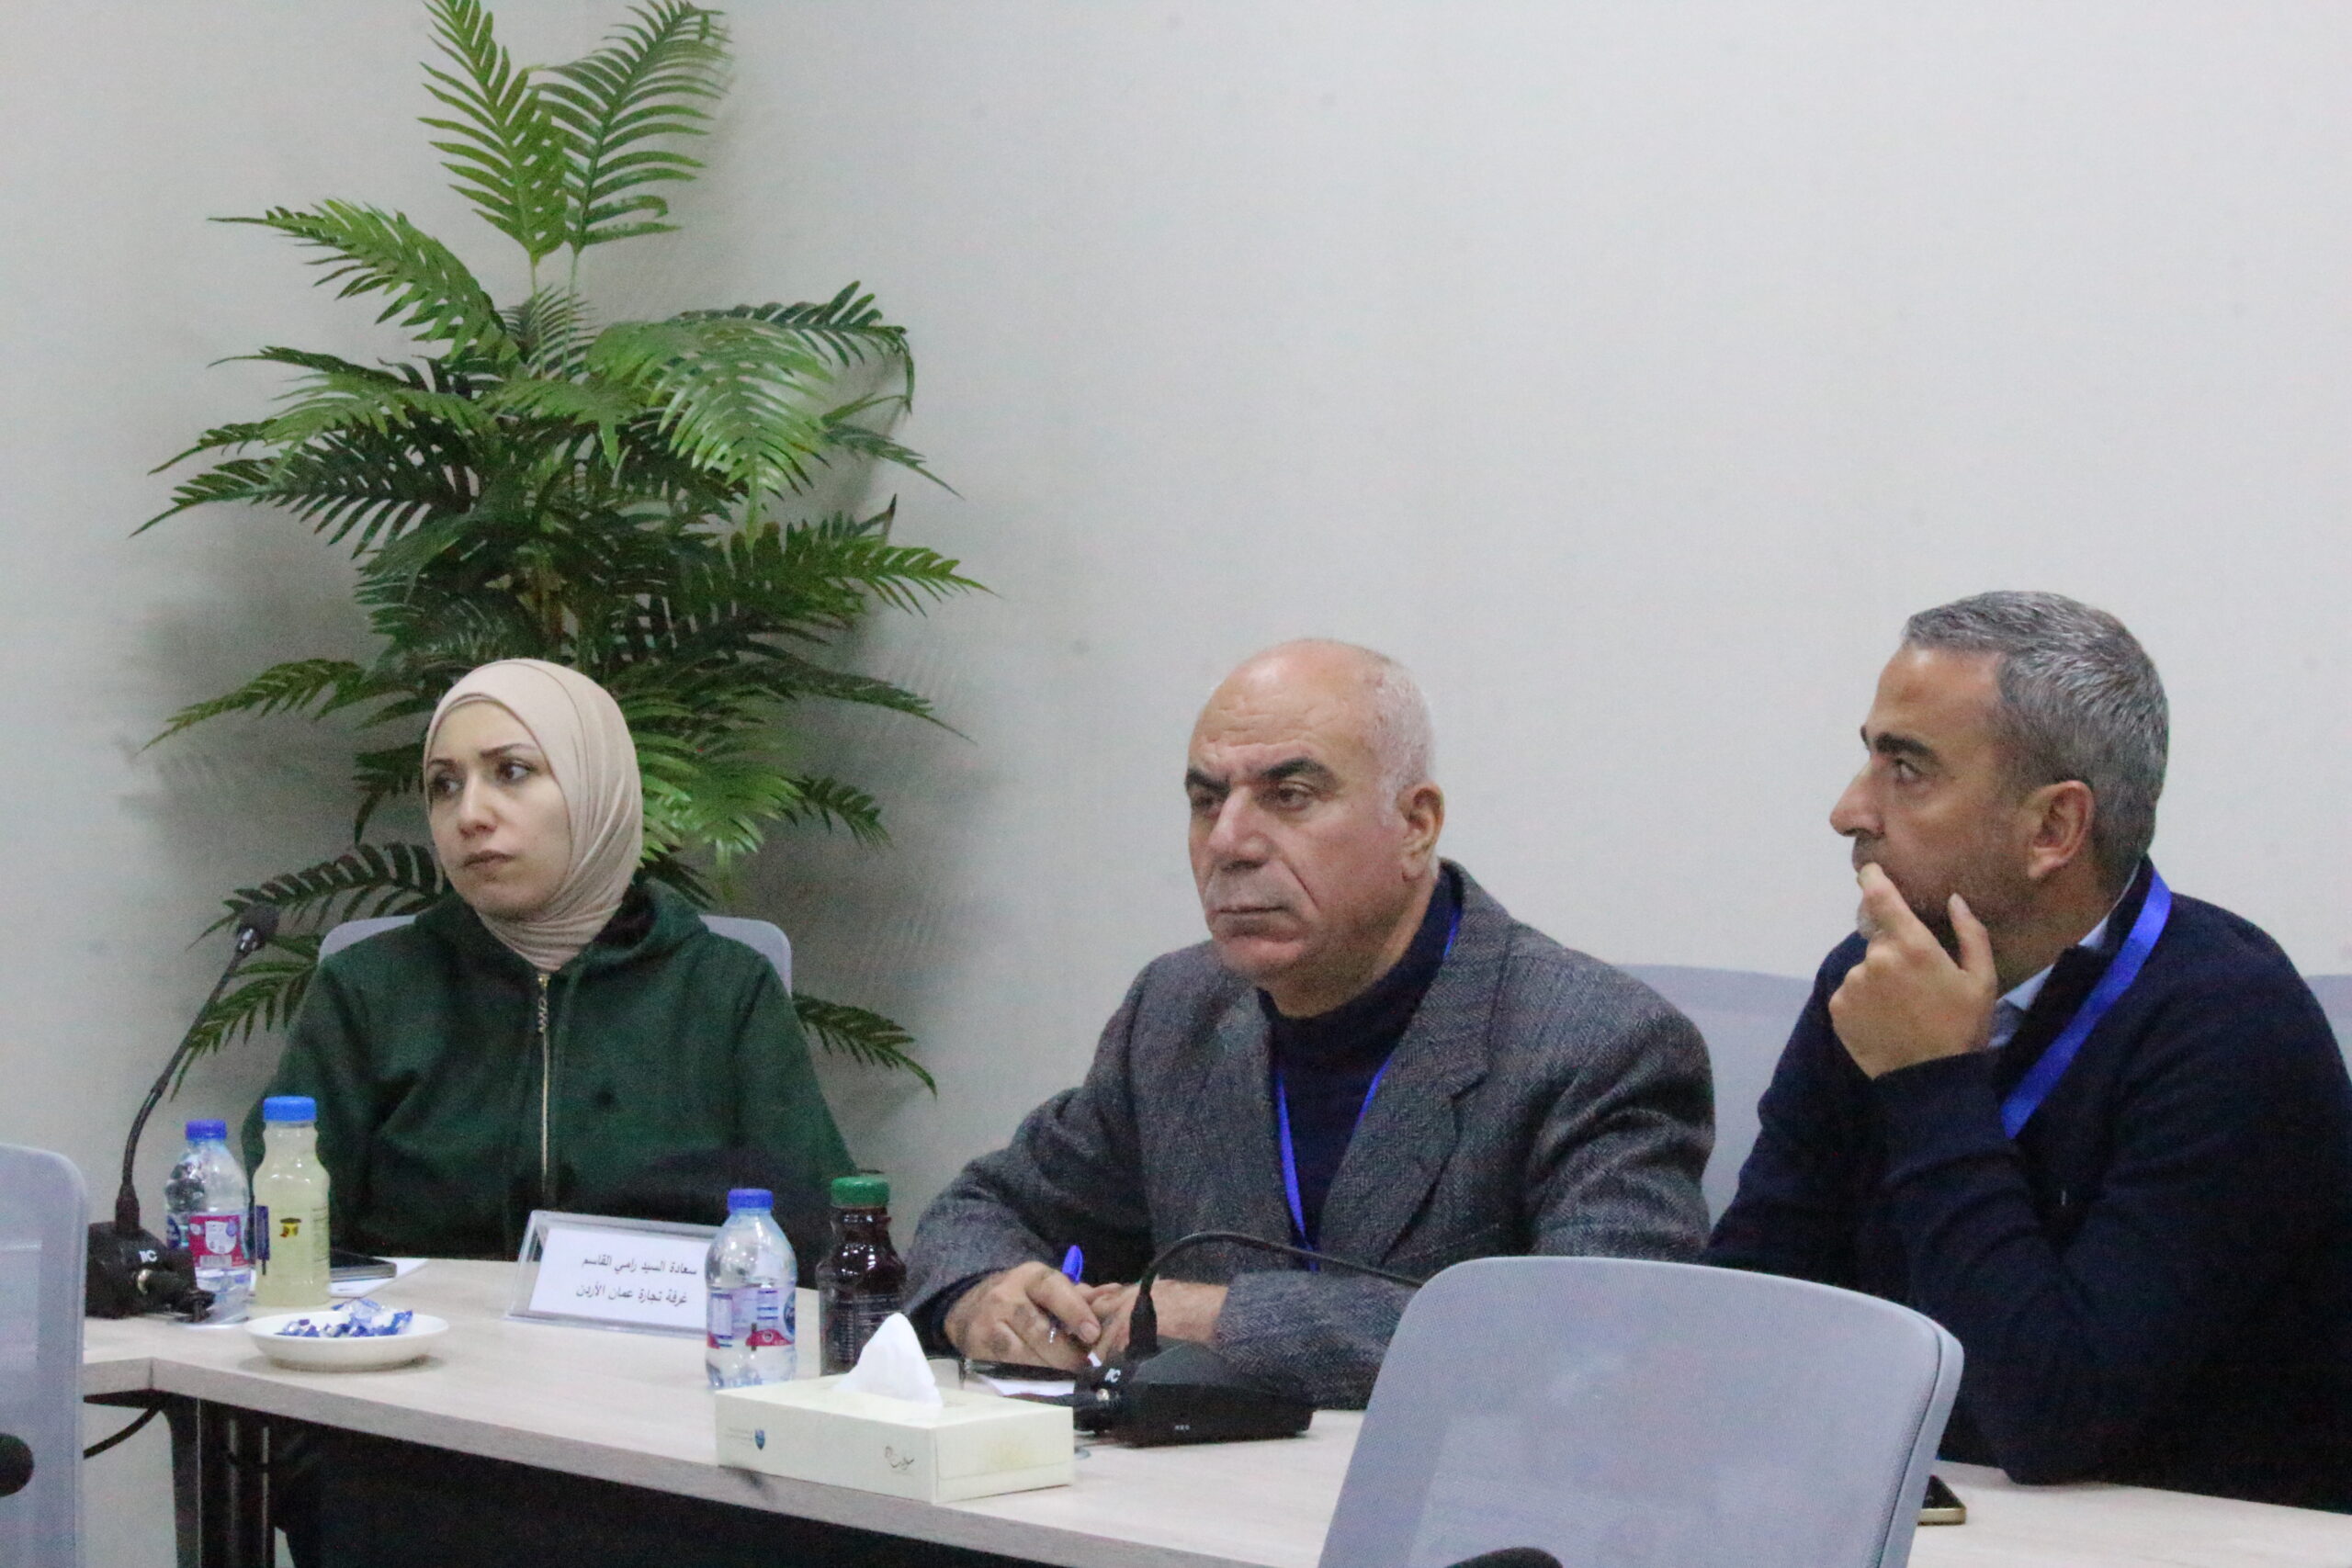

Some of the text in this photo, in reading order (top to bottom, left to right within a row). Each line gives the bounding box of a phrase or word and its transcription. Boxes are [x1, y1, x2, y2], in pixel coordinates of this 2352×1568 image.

[582, 1254, 697, 1275] سعادة السيد رامي القاسم
[575, 1280, 687, 1307] غرفة تجارة عمان الأردن
